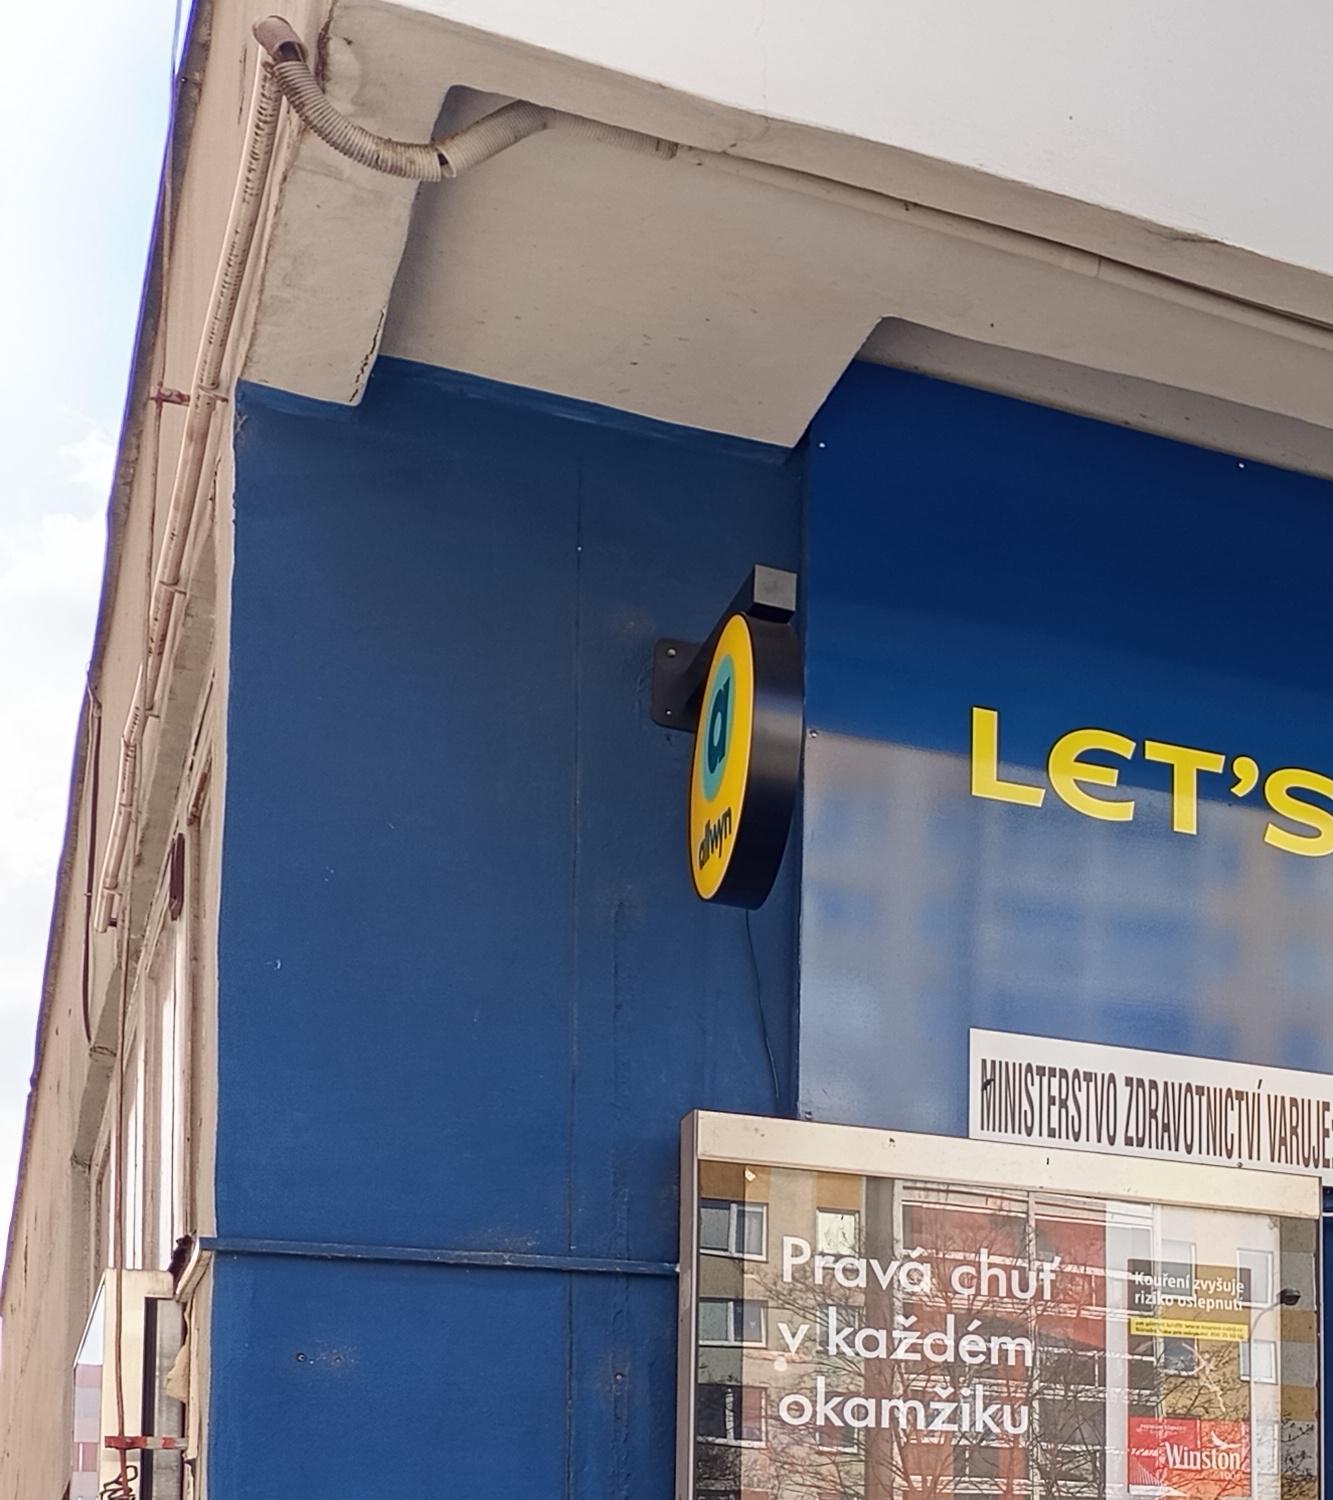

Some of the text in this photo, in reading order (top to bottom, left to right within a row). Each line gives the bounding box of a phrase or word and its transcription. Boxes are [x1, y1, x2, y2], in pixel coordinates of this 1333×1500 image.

[699, 807, 733, 870] allwyn
[980, 1058, 1117, 1147] MINISTERSTVO
[1123, 1076, 1263, 1162] ZDRAVOTNICTVÍ
[781, 1236, 1060, 1303] Pravá chuť
[1192, 1276, 1245, 1296] zvyšuje
[778, 1306, 1034, 1369] v každém
[778, 1375, 1031, 1435] okamžiku
[1164, 1441, 1241, 1470] Winston
